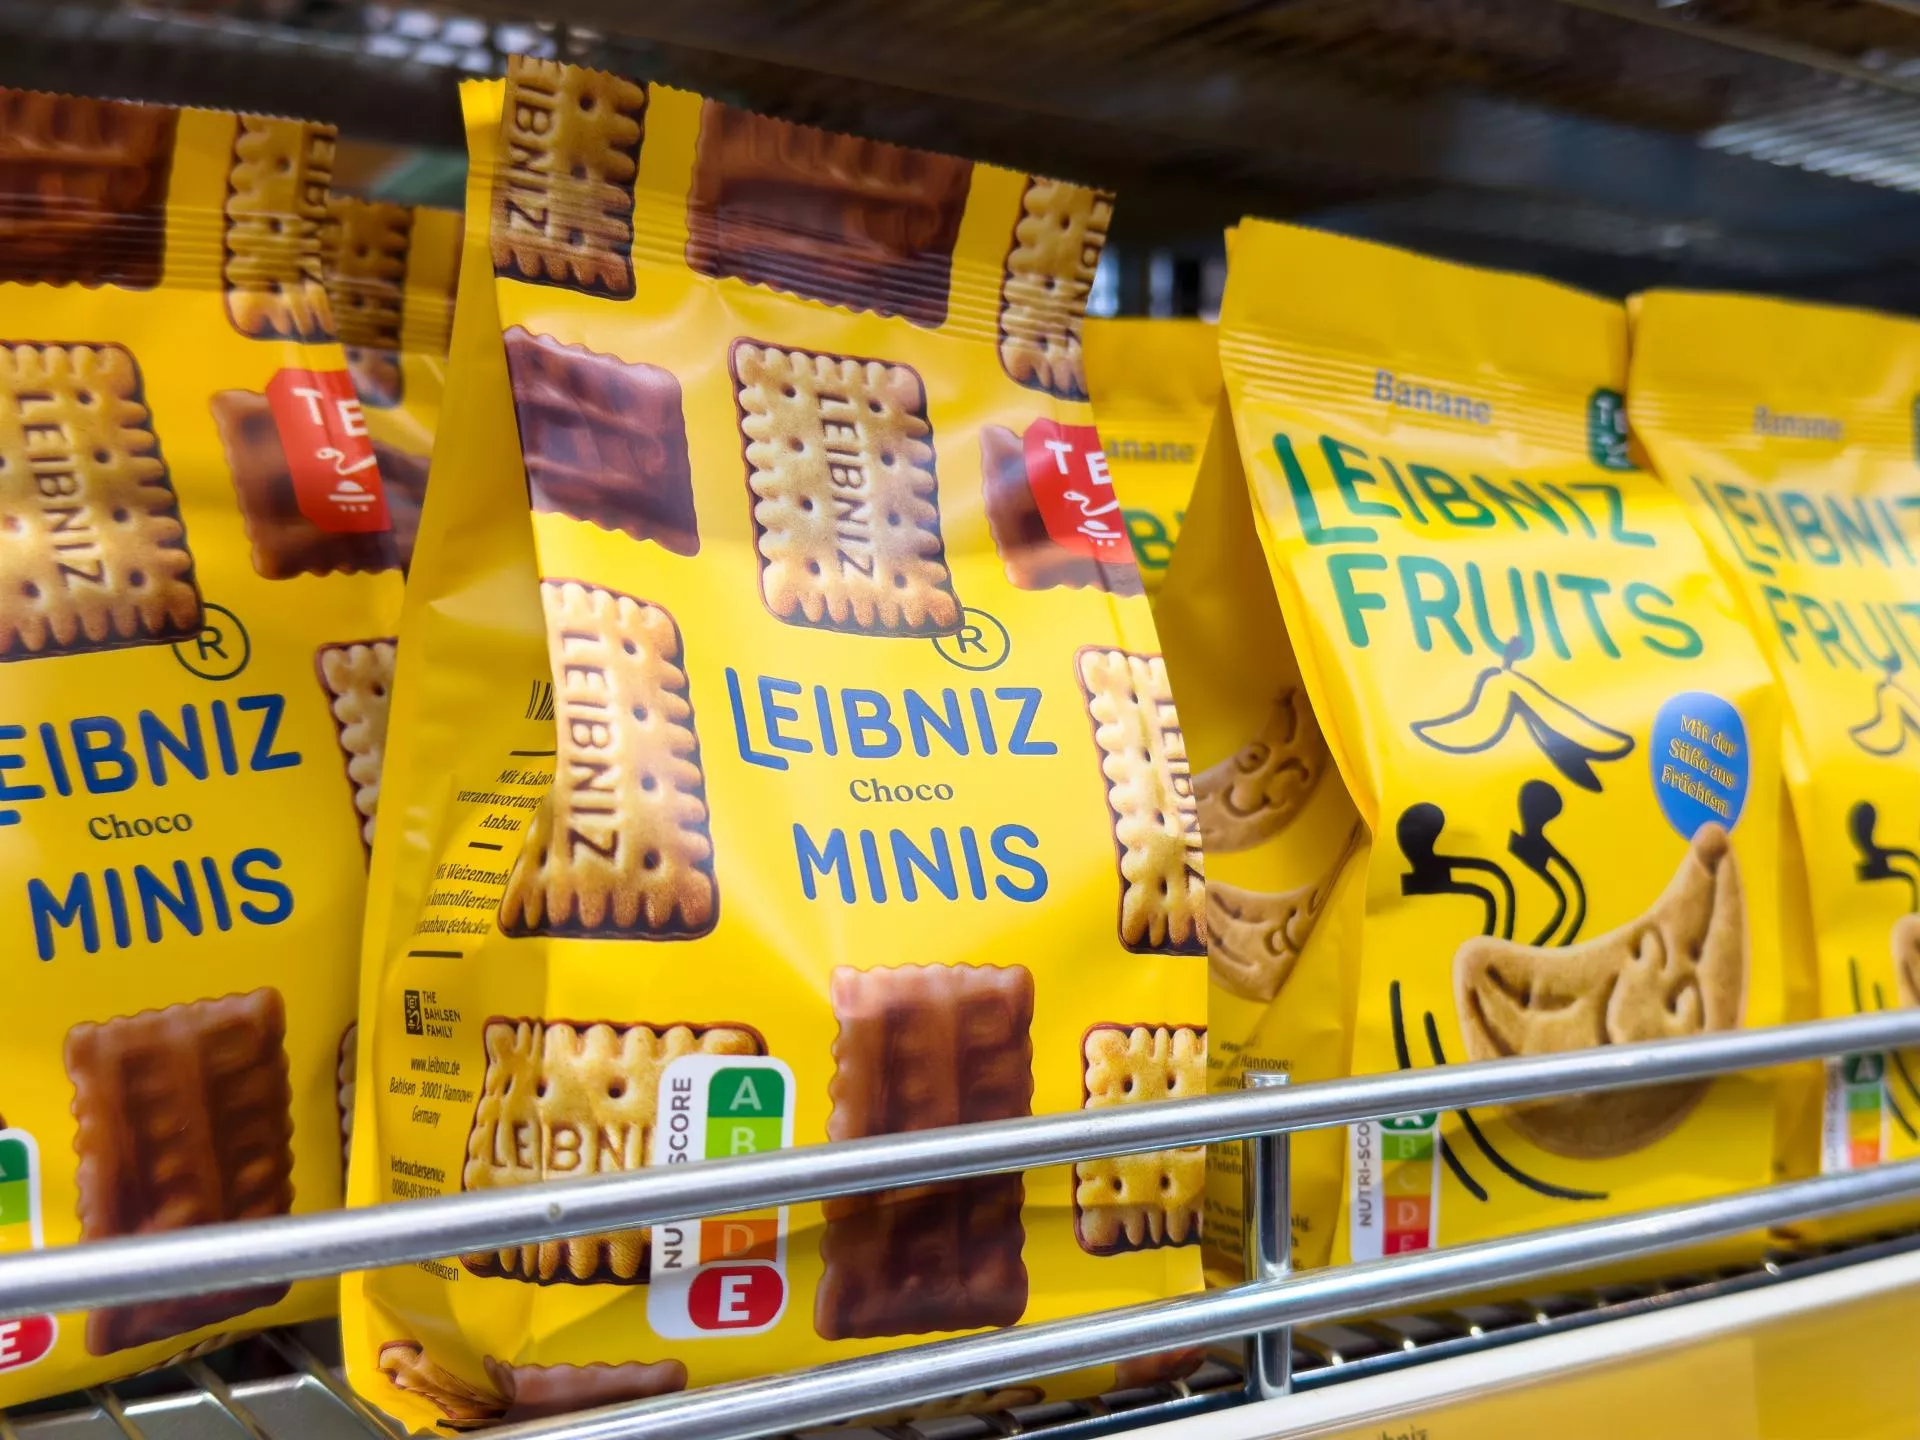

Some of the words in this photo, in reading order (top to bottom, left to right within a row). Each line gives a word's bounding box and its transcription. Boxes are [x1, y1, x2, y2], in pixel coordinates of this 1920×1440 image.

[1372, 369, 1495, 425] Banane
[1103, 438, 1196, 463] anane
[15, 392, 109, 589] LEIBNIZ
[817, 391, 875, 579] LEIBNIZ
[1272, 433, 1658, 547] LEIBNIZ
[1688, 473, 1920, 578] LEIBNI
[1326, 553, 1705, 660] FRUITS
[1759, 584, 1920, 672] FRUI
[724, 666, 1058, 771] LEIBNIZ
[0, 693, 303, 827] EIBNIZ
[560, 631, 619, 863] LEIBNIZ
[496, 770, 516, 784] Mit
[516, 771, 551, 786] Kakao
[849, 777, 955, 804] Choco
[88, 813, 194, 842] Choco
[478, 812, 522, 832] Anbau.
[792, 823, 1050, 905] MINIS
[27, 846, 295, 963] MINIS
[422, 990, 437, 1004] THE
[424, 1007, 462, 1023] BAHLSEN
[426, 1024, 454, 1039] FAMILY
[389, 1076, 417, 1096] Bahlsen
[420, 1080, 443, 1100] 30001
[442, 1083, 475, 1103] Hannover
[410, 1056, 461, 1076] www.leibniz.de
[411, 1104, 441, 1128] Germany
[729, 1075, 763, 1111] A
[1356, 1120, 1373, 1228] NUTRI-SCO
[722, 1223, 755, 1257] D
[717, 1274, 753, 1322] E
